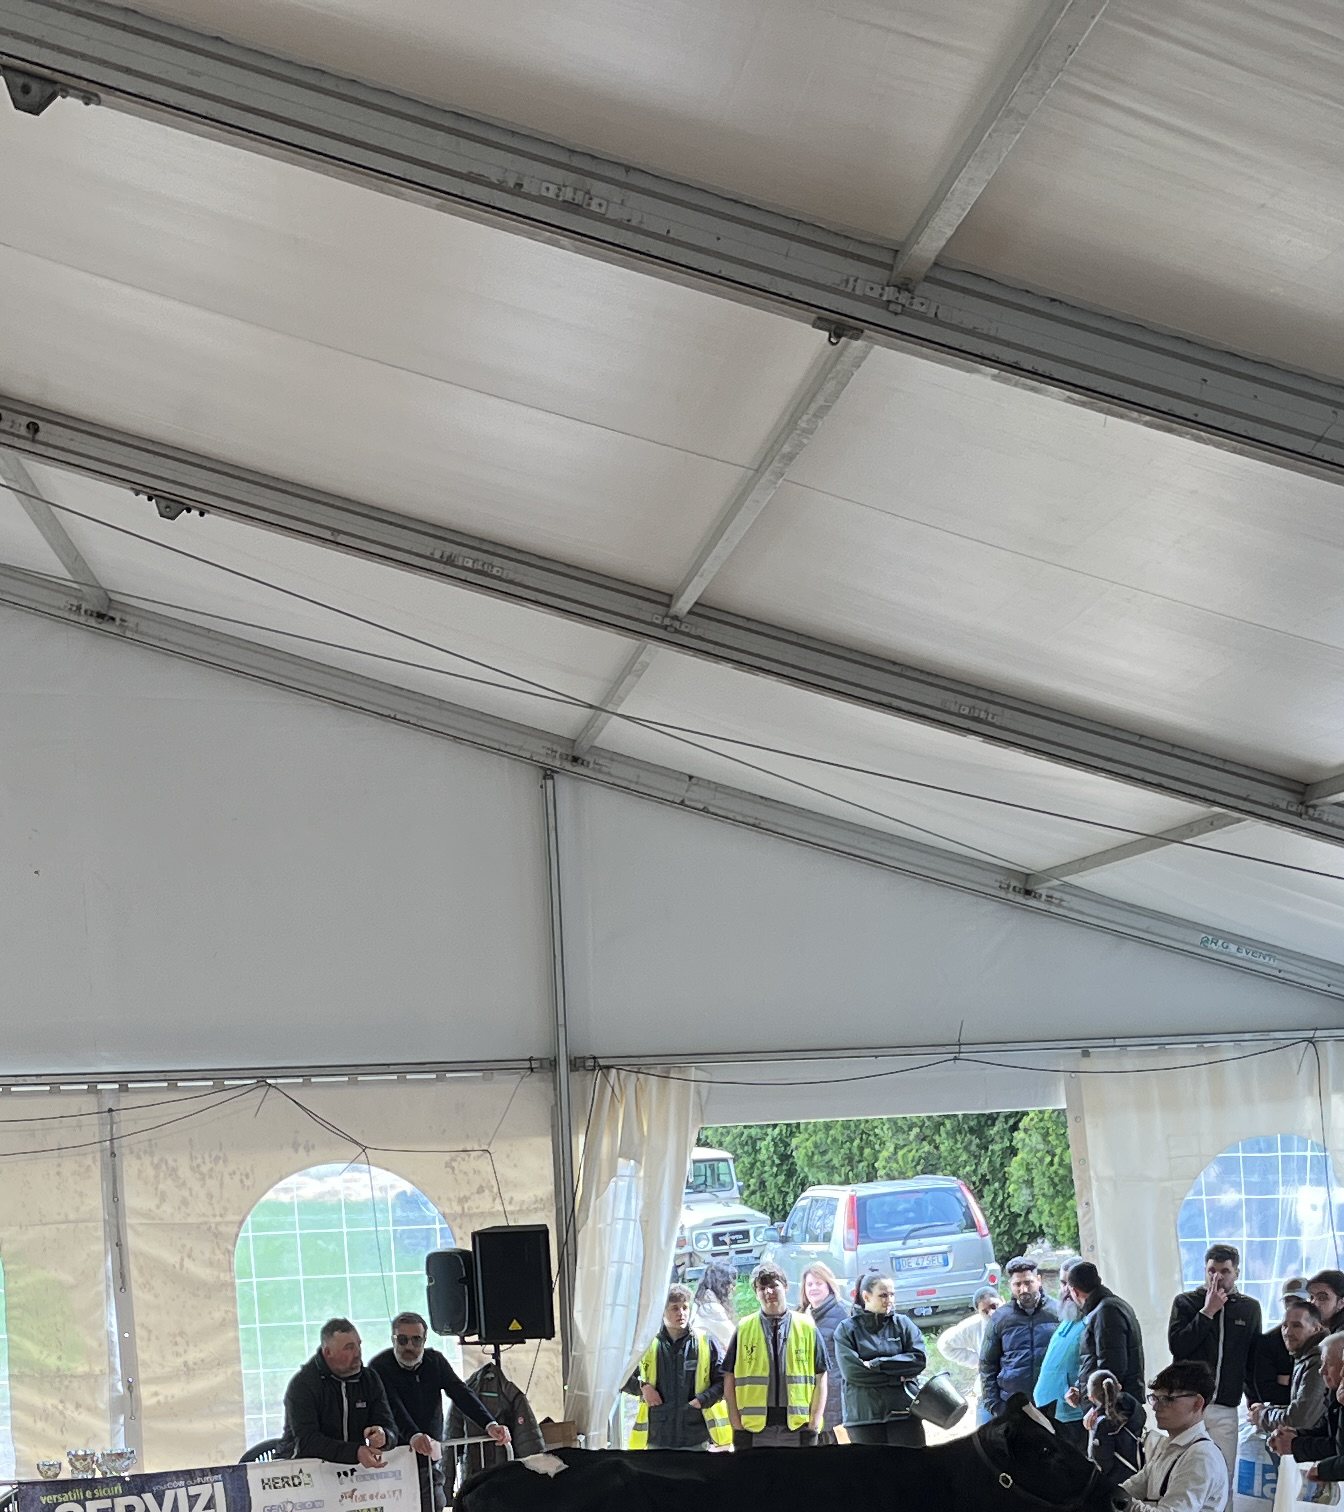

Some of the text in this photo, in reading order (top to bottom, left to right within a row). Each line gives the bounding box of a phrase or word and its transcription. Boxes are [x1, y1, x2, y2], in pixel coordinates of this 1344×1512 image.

[1236, 946, 1277, 964] EVENTI
[39, 1483, 123, 1504] versatili e sicuri
